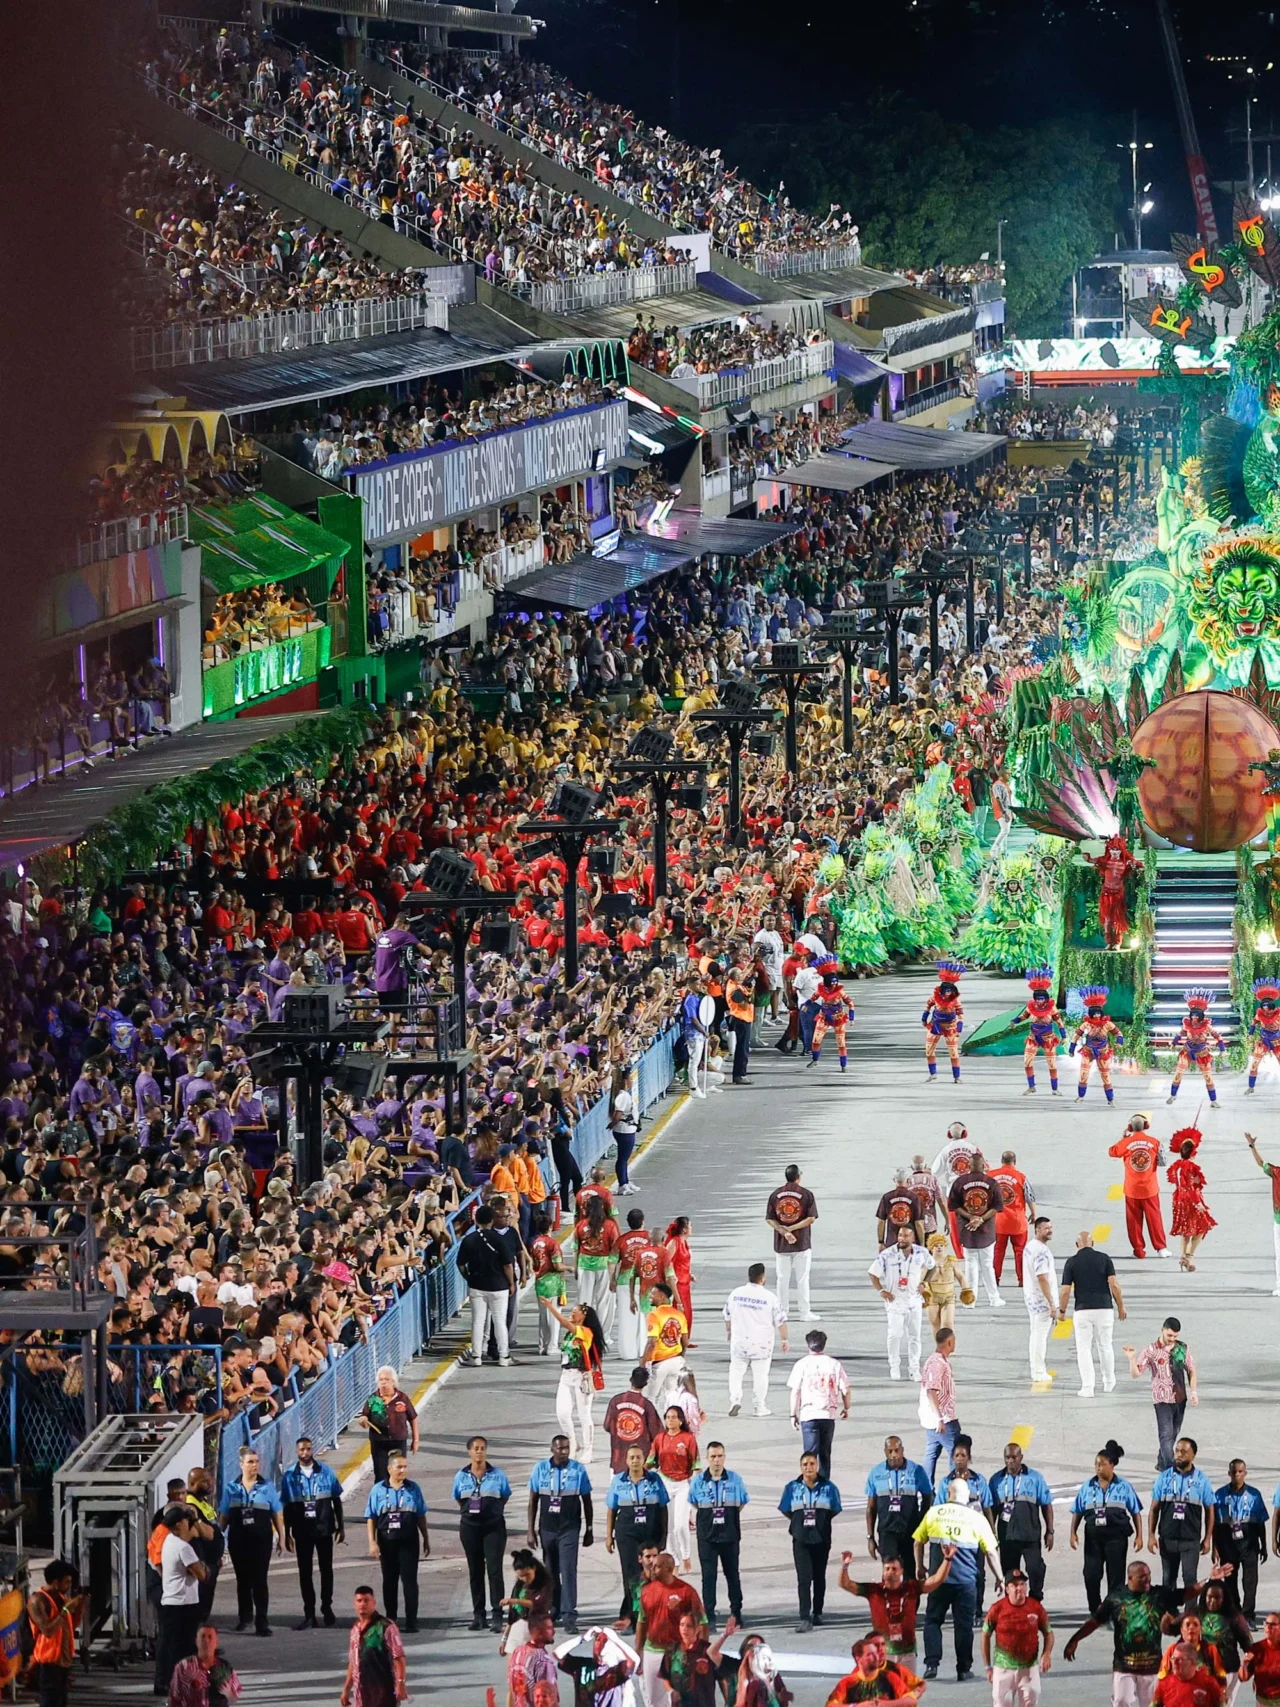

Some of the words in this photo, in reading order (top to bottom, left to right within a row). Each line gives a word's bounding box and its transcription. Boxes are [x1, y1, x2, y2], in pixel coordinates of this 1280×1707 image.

[386, 468, 400, 534] DE
[402, 459, 434, 528] CORES
[444, 452, 468, 517] MAR
[467, 448, 480, 508] DE
[480, 435, 516, 504] SONHOS
[524, 427, 545, 488] MAR
[545, 426, 556, 480] DE
[556, 416, 594, 477] SORRISOS
[733, 1296, 768, 1305] DIRETORIA
[945, 1525, 961, 1536] 30
